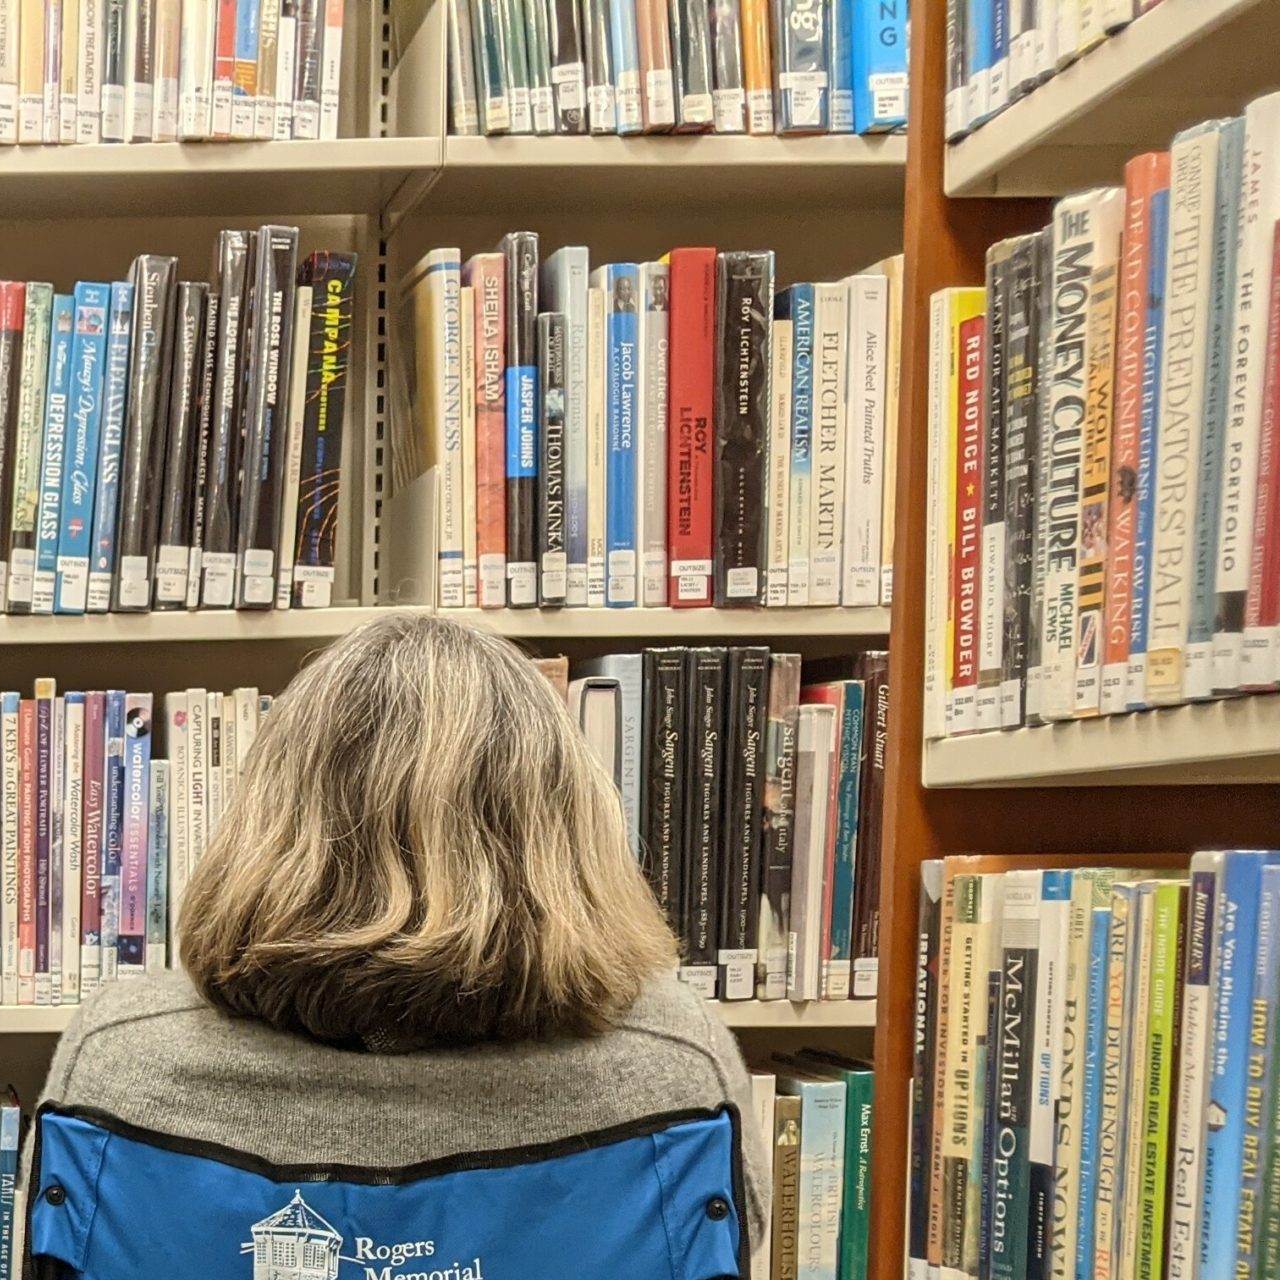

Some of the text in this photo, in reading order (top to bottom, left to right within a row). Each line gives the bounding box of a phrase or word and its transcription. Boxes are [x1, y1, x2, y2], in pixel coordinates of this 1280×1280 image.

[84, 28, 94, 96] TREATMENTS
[267, 291, 283, 404] THE ROSE WINDOW
[322, 279, 343, 383] CAMPANA
[444, 278, 461, 451] GEORGE INNESS
[485, 276, 498, 400] SHEILA ISHAM
[740, 297, 752, 414] ROY LICHTENSTEIN
[794, 298, 810, 463] AMERICAN REALISM
[521, 375, 534, 468] JASPER JOHNS
[622, 342, 635, 448] Jacob Lawrence
[694, 417, 707, 455] ROY
[818, 332, 839, 549] FLETCHER MARTIN
[863, 331, 876, 484] Alice Neel Painted Truths
[1050, 243, 1094, 573] MONEY CULTURE
[1110, 196, 1146, 645] DEAD COMPANIES WALKING
[1151, 214, 1198, 641] THE PREDATORS' BALL
[41, 393, 65, 540] DEPRESSION GLASS
[679, 407, 692, 535] LICHTENSTEIN
[958, 336, 981, 678] RED NOTICE BILL BROWDER
[1046, 597, 1060, 643] LEWIS
[1058, 583, 1074, 653] MICHAEL
[744, 729, 760, 777] Sargent
[850, 709, 860, 773] COMMON MAN
[874, 684, 889, 769] Gilbert Stuart
[69, 778, 81, 871] Watercolor Wash
[85, 780, 102, 898] Easy Watercolor
[106, 766, 120, 865] understanding color
[129, 742, 143, 892] watercolor ESSENTIALS
[744, 783, 752, 820] FIGURES
[776, 727, 798, 852] sargent italy
[741, 846, 749, 905] LANDSCAPES,
[1191, 891, 1207, 971] KIPLINGER'S
[917, 932, 928, 1053] IRRATIONAL
[953, 1069, 968, 1146] OPTIONS
[993, 955, 1024, 1254] McMillan Options
[1039, 1053, 1051, 1106] OPTIONS
[1148, 1032, 1162, 1096] FUNDING
[860, 1104, 870, 1153] Max Ernst
[1144, 1141, 1158, 1195] ESTATE
[1146, 1101, 1160, 1136] REAL
[809, 1152, 824, 1272] WATERCOLOURS
[1175, 1145, 1194, 1210] Real
[355, 1237, 435, 1266] Rogers
